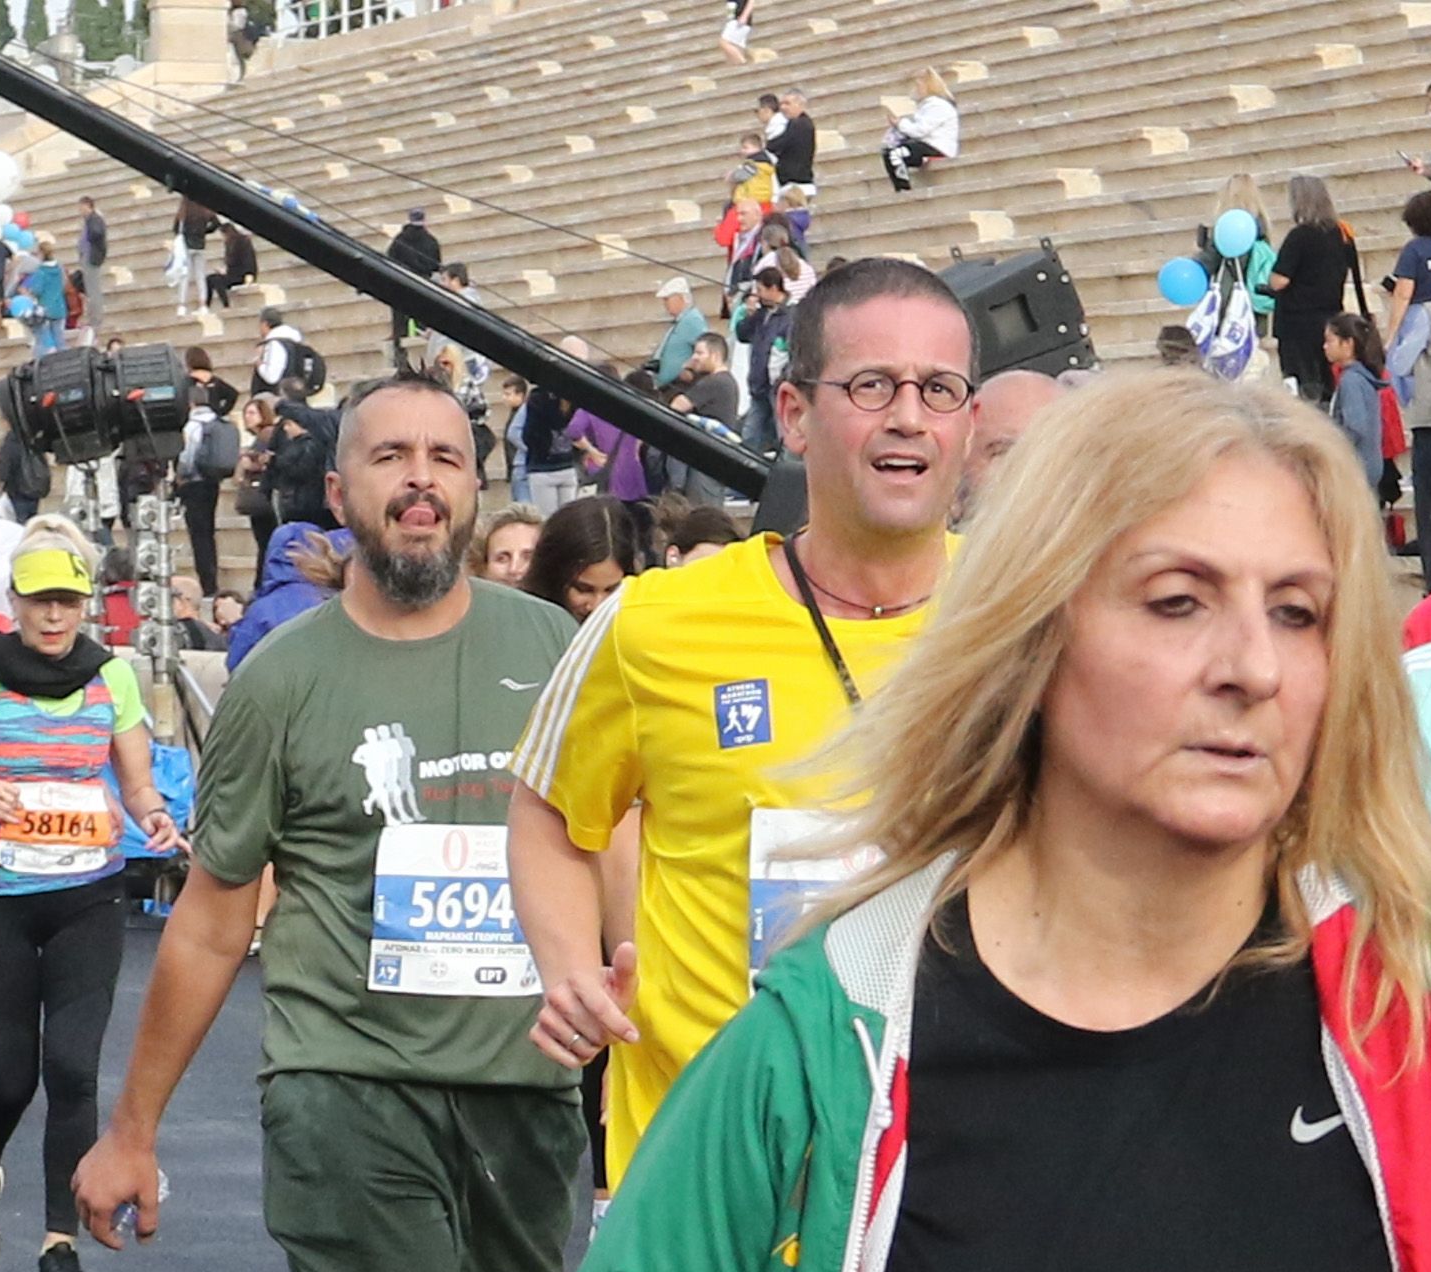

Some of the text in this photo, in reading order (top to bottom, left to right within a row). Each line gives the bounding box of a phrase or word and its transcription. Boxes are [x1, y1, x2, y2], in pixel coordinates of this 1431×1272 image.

[419, 752, 487, 779] MOTOR
[22, 811, 97, 838] 58164
[408, 881, 515, 929] 5694
